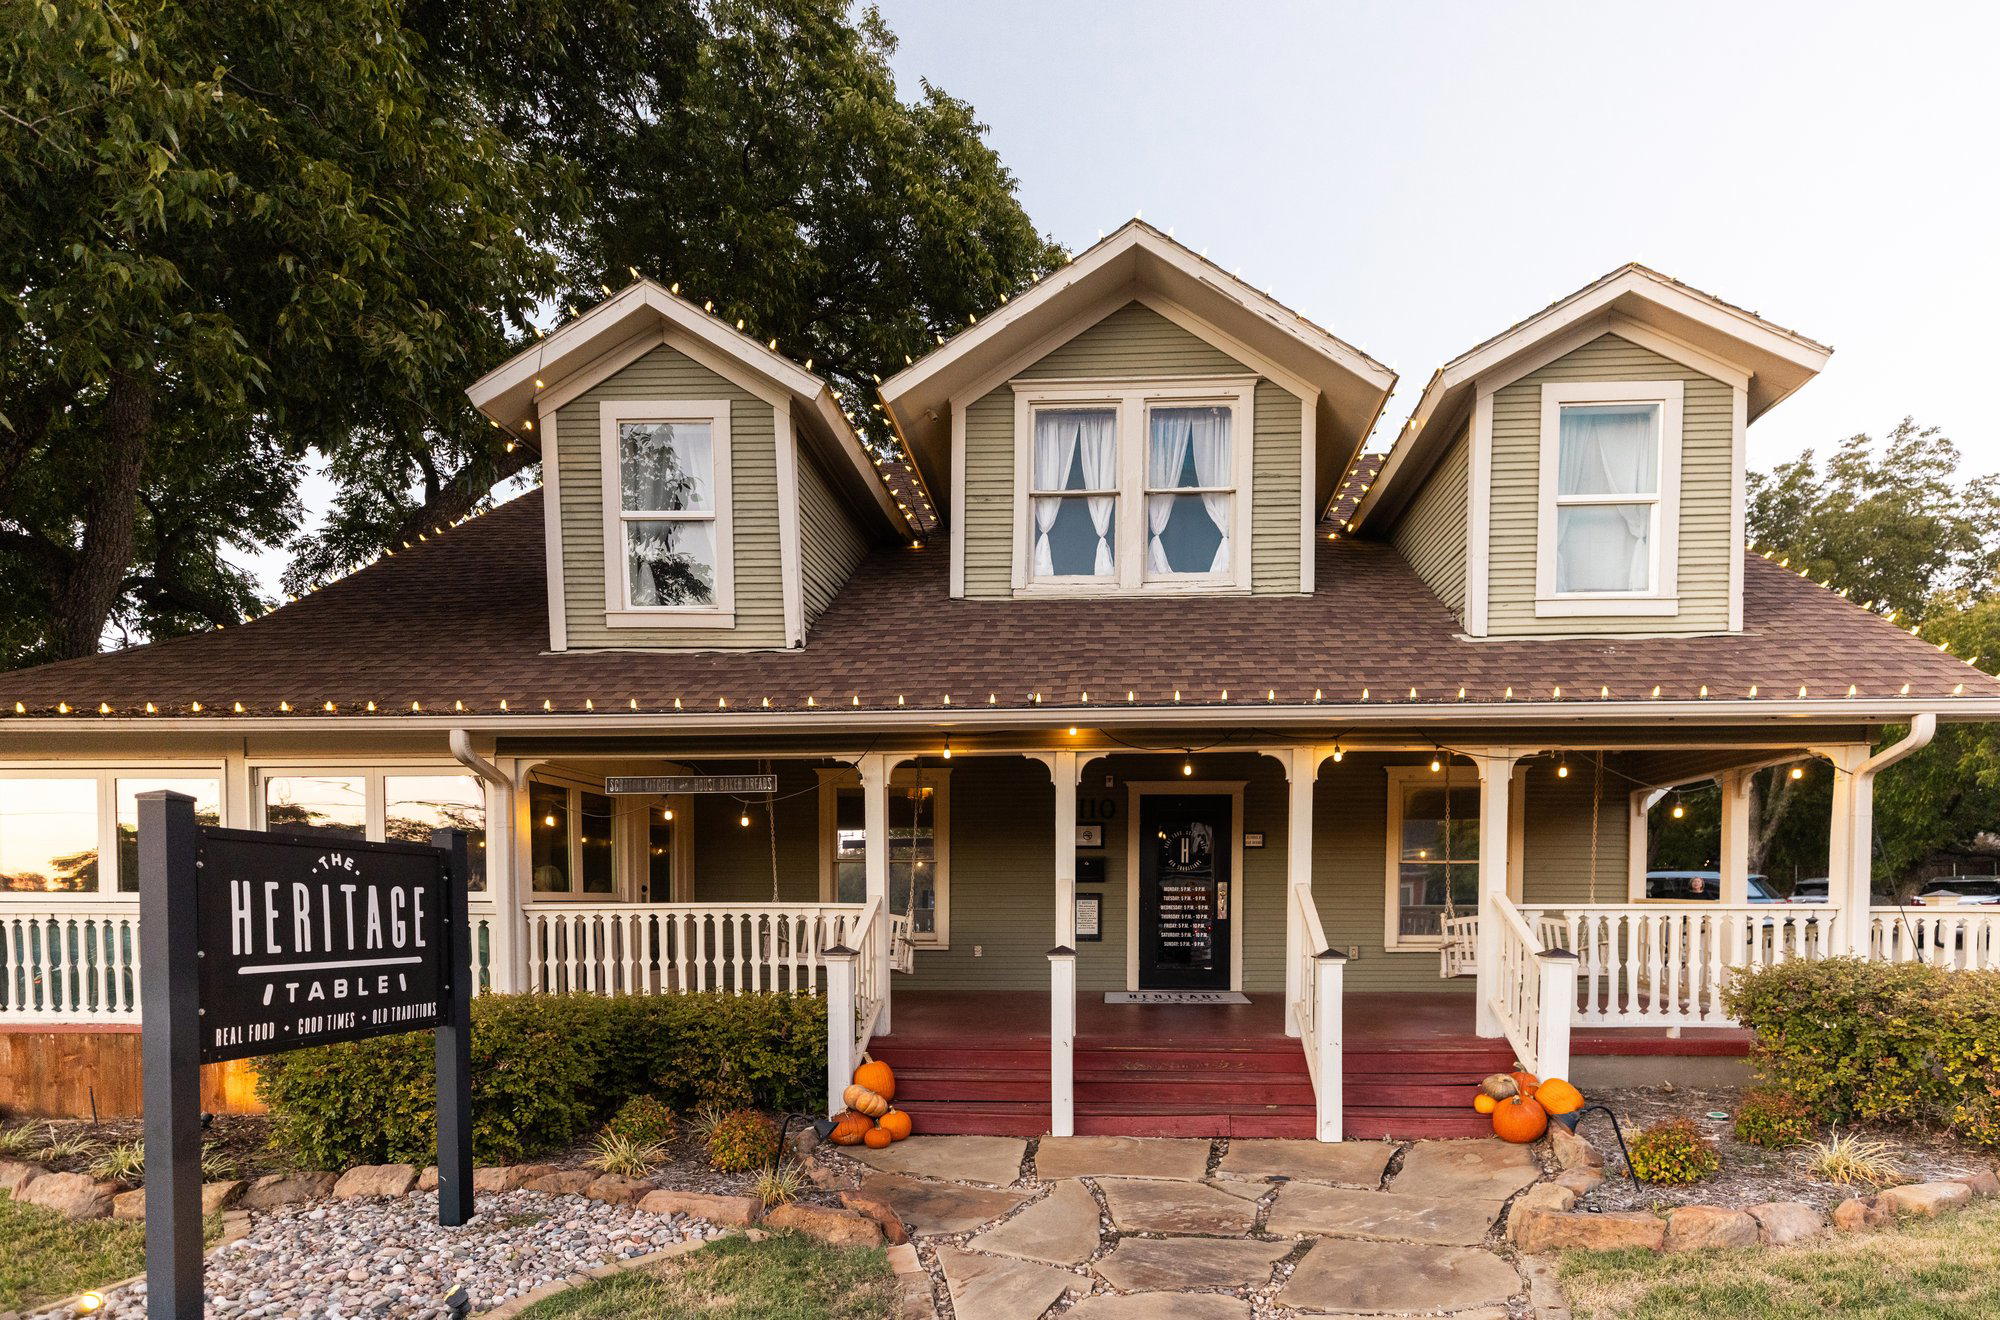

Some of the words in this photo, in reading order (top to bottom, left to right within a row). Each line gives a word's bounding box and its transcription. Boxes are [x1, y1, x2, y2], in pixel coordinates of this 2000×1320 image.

[694, 778, 716, 791] HOUSE
[720, 778, 742, 791] BAKED
[746, 777, 772, 790] BREADS
[318, 852, 354, 872] THE
[1181, 838, 1189, 863] H
[230, 880, 426, 956] HERITAGE
[286, 975, 389, 1003] TABLE
[215, 1028, 243, 1047] REAL
[248, 1022, 275, 1042] FOOD
[298, 1017, 323, 1036] GOOD
[327, 1012, 356, 1031] TIMES
[372, 1008, 388, 1025] OLD
[391, 1002, 437, 1021] TRADITIONS
